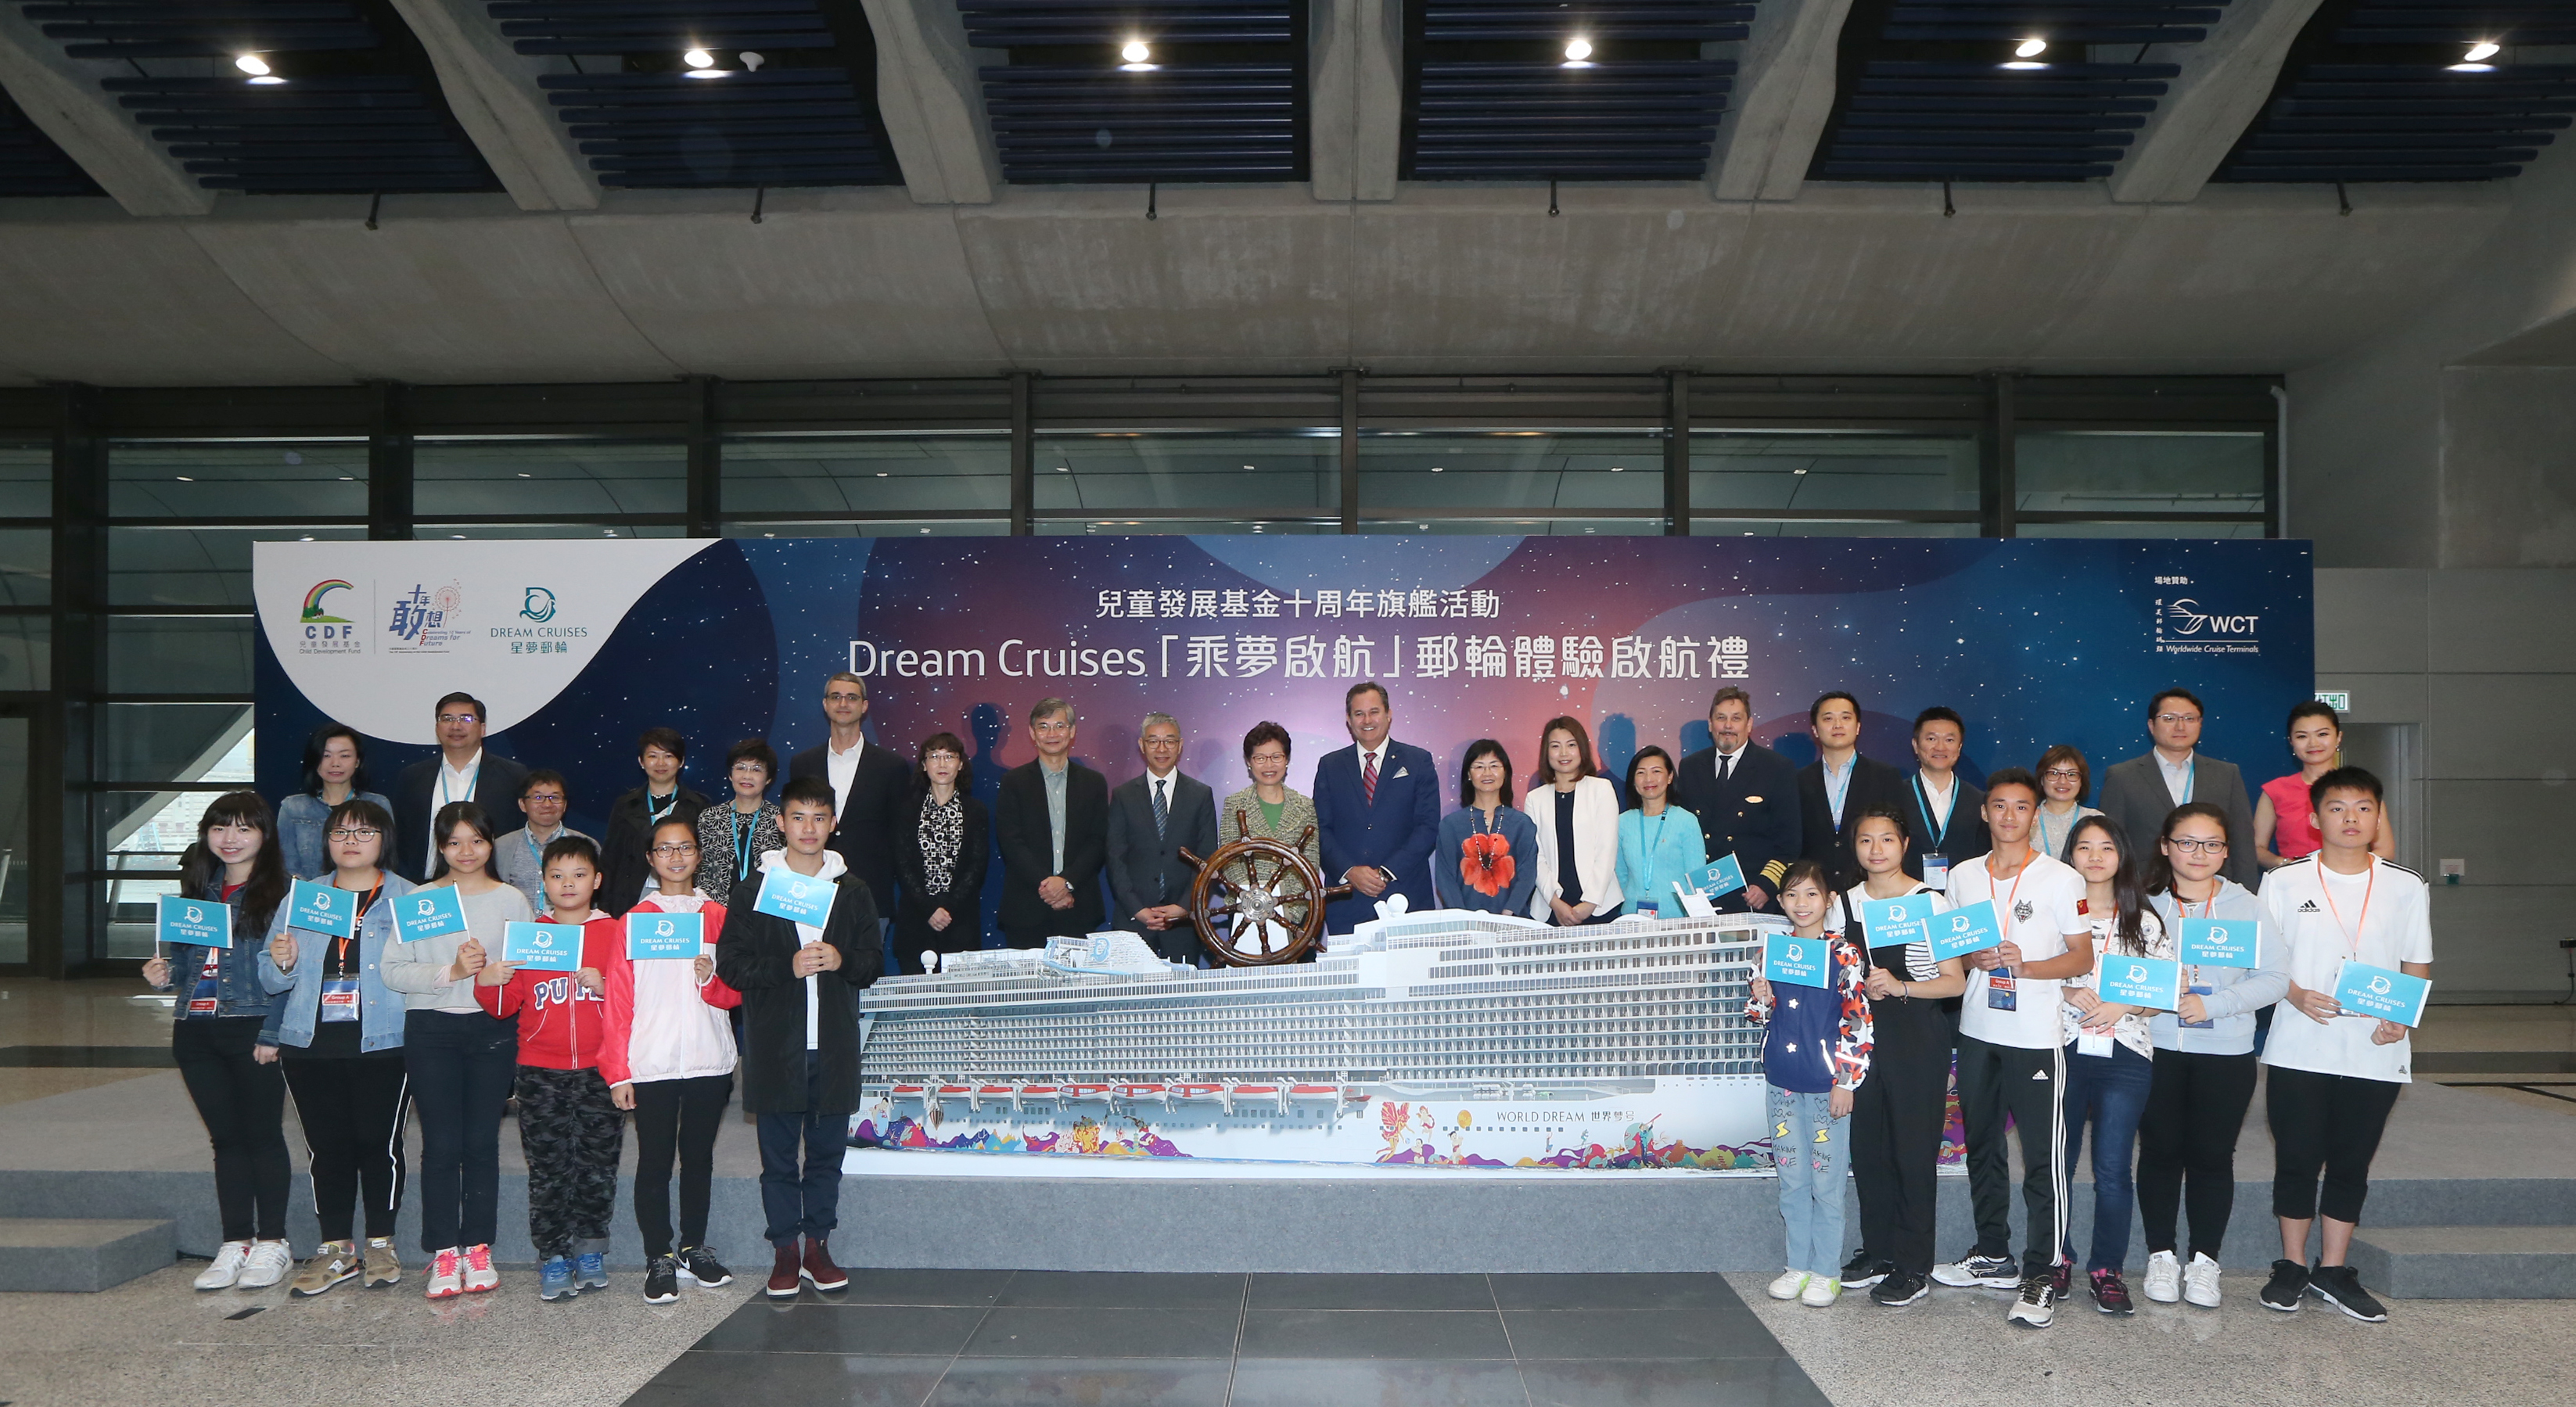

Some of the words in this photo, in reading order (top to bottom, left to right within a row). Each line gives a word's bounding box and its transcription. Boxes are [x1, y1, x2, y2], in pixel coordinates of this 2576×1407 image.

[1096, 589, 1500, 619] 兒童發展基金十周年旗艦活動
[490, 627, 533, 637] DREAM
[537, 627, 587, 637] CRUISES
[2209, 616, 2259, 633] WCT
[305, 626, 353, 640] CDF
[511, 641, 568, 654] 星夢郵輪
[2166, 645, 2202, 654] Worldwide
[2204, 644, 2226, 653] Cruise
[2226, 644, 2259, 653] Terminals
[848, 639, 986, 677] Dream
[997, 639, 1146, 678] Cruises
[771, 893, 792, 903] DREAM
[794, 900, 818, 910] CRUISES
[300, 906, 319, 915] DREAM
[320, 911, 343, 921] CRUISES
[406, 918, 427, 927] DREAM
[428, 912, 452, 922] CRUISES
[1940, 935, 1962, 945] DREAM
[1963, 928, 1989, 938] CRUISES
[2135, 984, 2164, 993] CRUISES
[2348, 988, 2373, 1000] DREAM
[2375, 996, 2406, 1008] CRUISES
[1497, 1111, 1539, 1122] WORLD
[1543, 1111, 1585, 1122] DREAM
